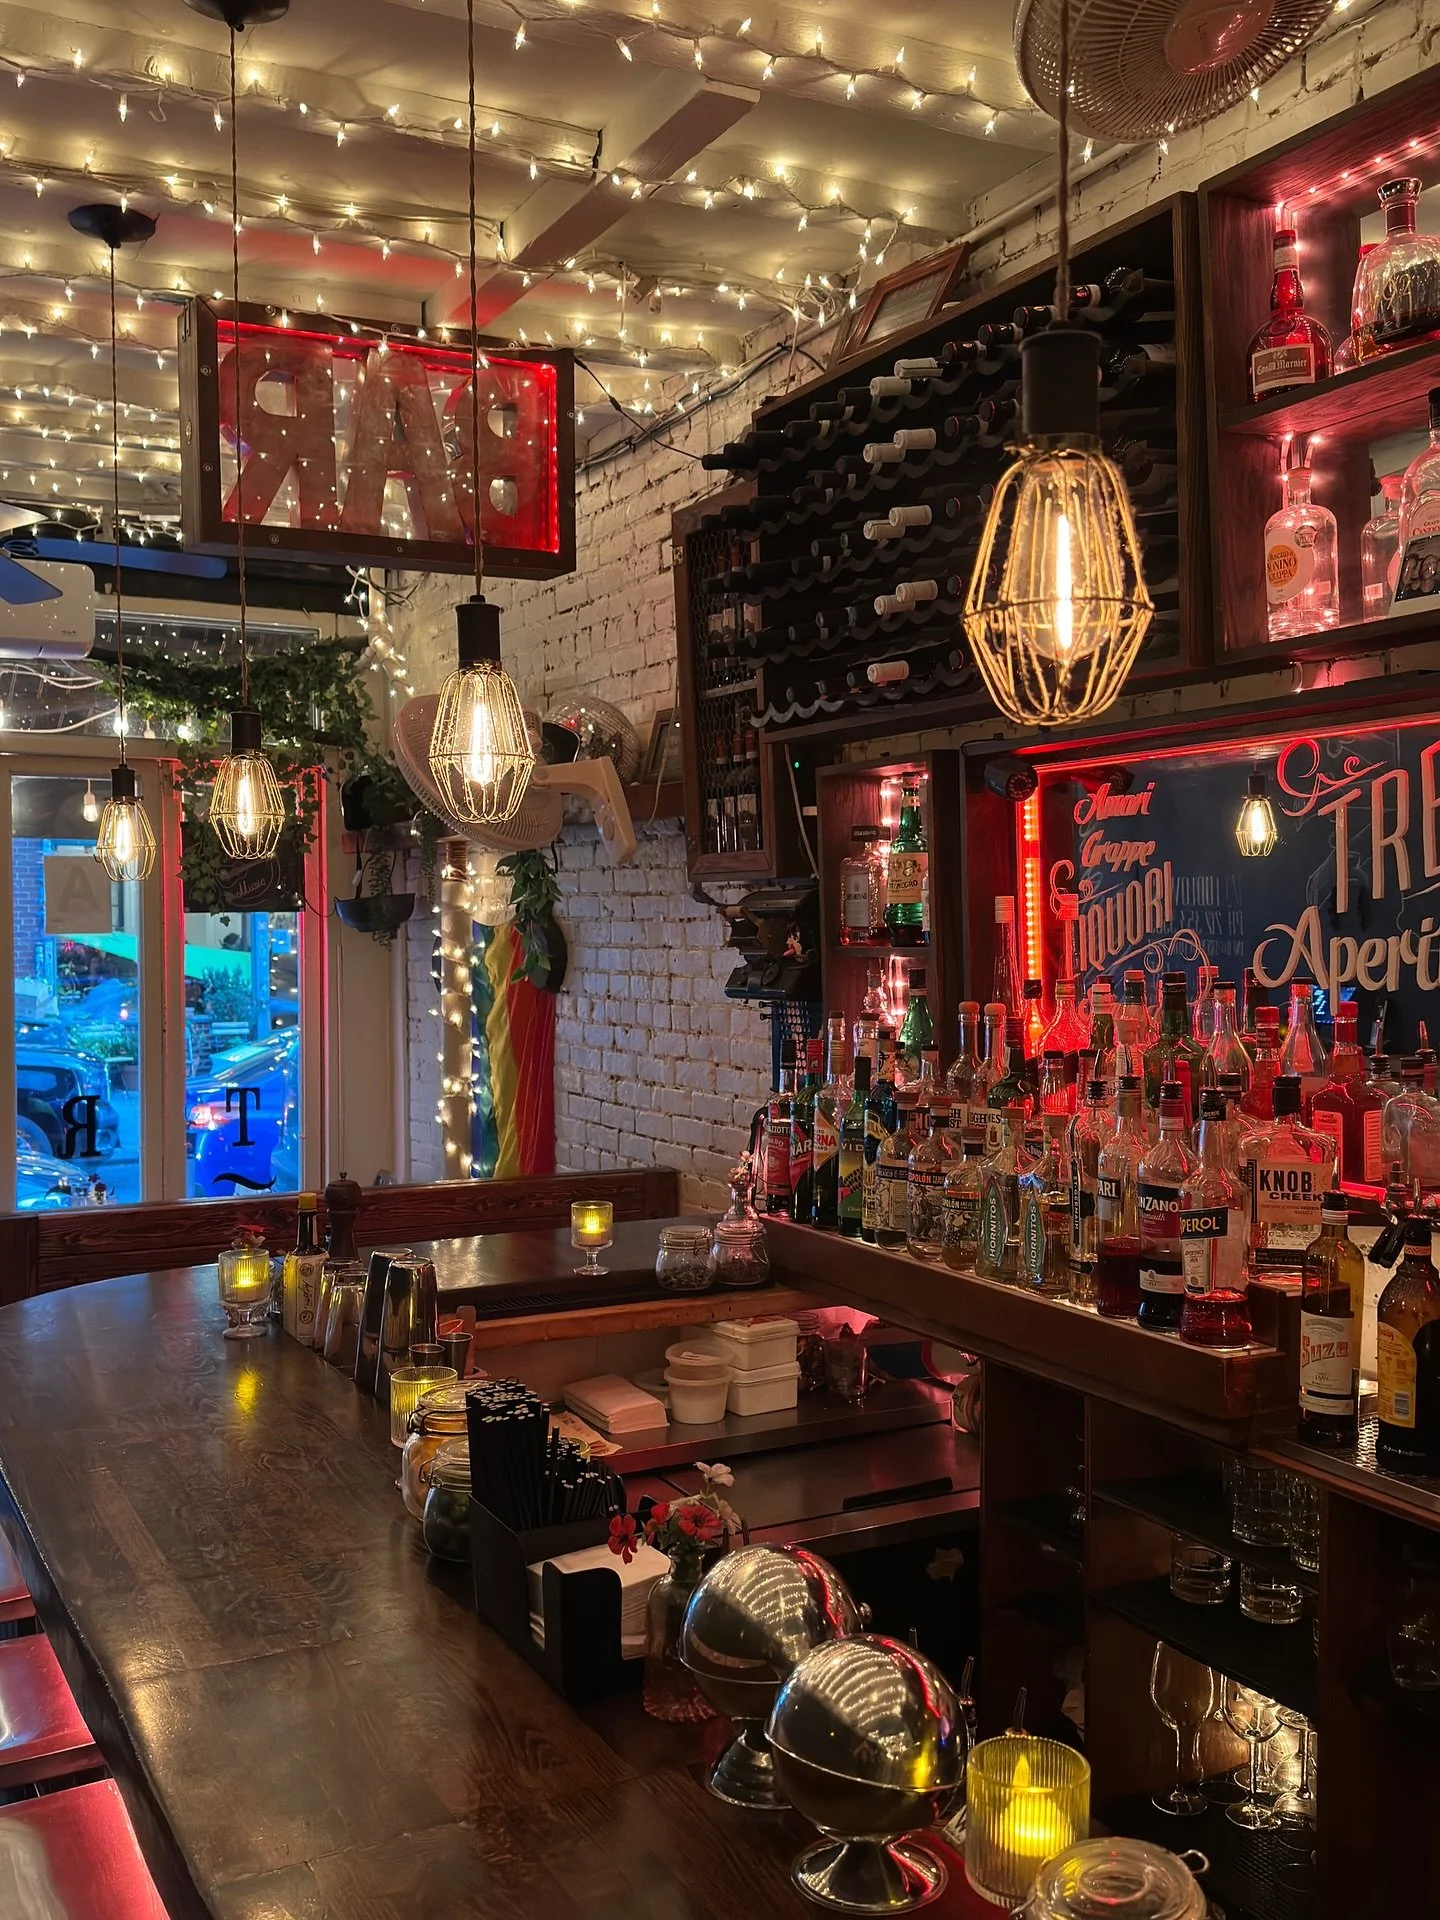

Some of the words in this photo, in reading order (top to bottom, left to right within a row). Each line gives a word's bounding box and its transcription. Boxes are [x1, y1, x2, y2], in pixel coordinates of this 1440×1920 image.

[1081, 830, 1157, 872] Grappe
[1253, 905, 1440, 1017] Aperi
[840, 1143, 864, 1152] VID
[1260, 1169, 1312, 1193] KNOB
[1269, 1191, 1323, 1202] CREEK
[989, 1197, 997, 1259] HORNITOS
